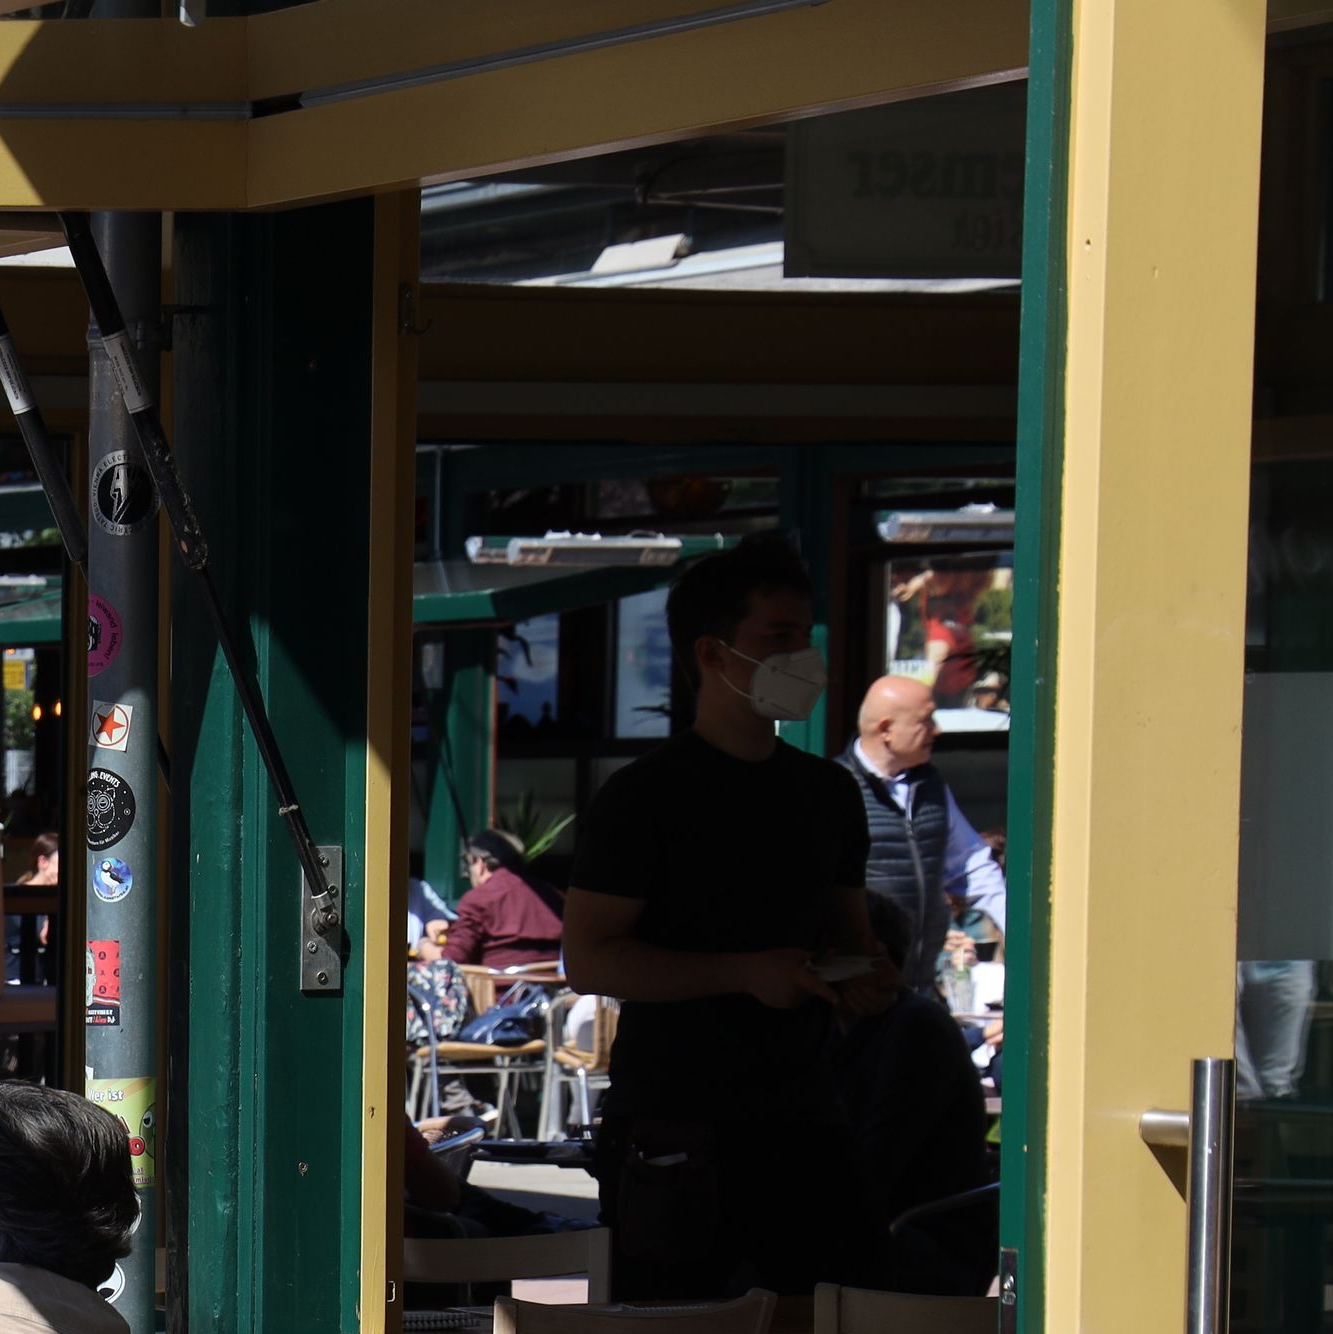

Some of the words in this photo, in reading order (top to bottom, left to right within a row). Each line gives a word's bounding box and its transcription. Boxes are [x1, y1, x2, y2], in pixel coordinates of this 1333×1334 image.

[95, 599, 118, 629] leiwand
[99, 771, 121, 788] EVENTS
[88, 1088, 104, 1102] Wer
[108, 1089, 123, 1102] ist
